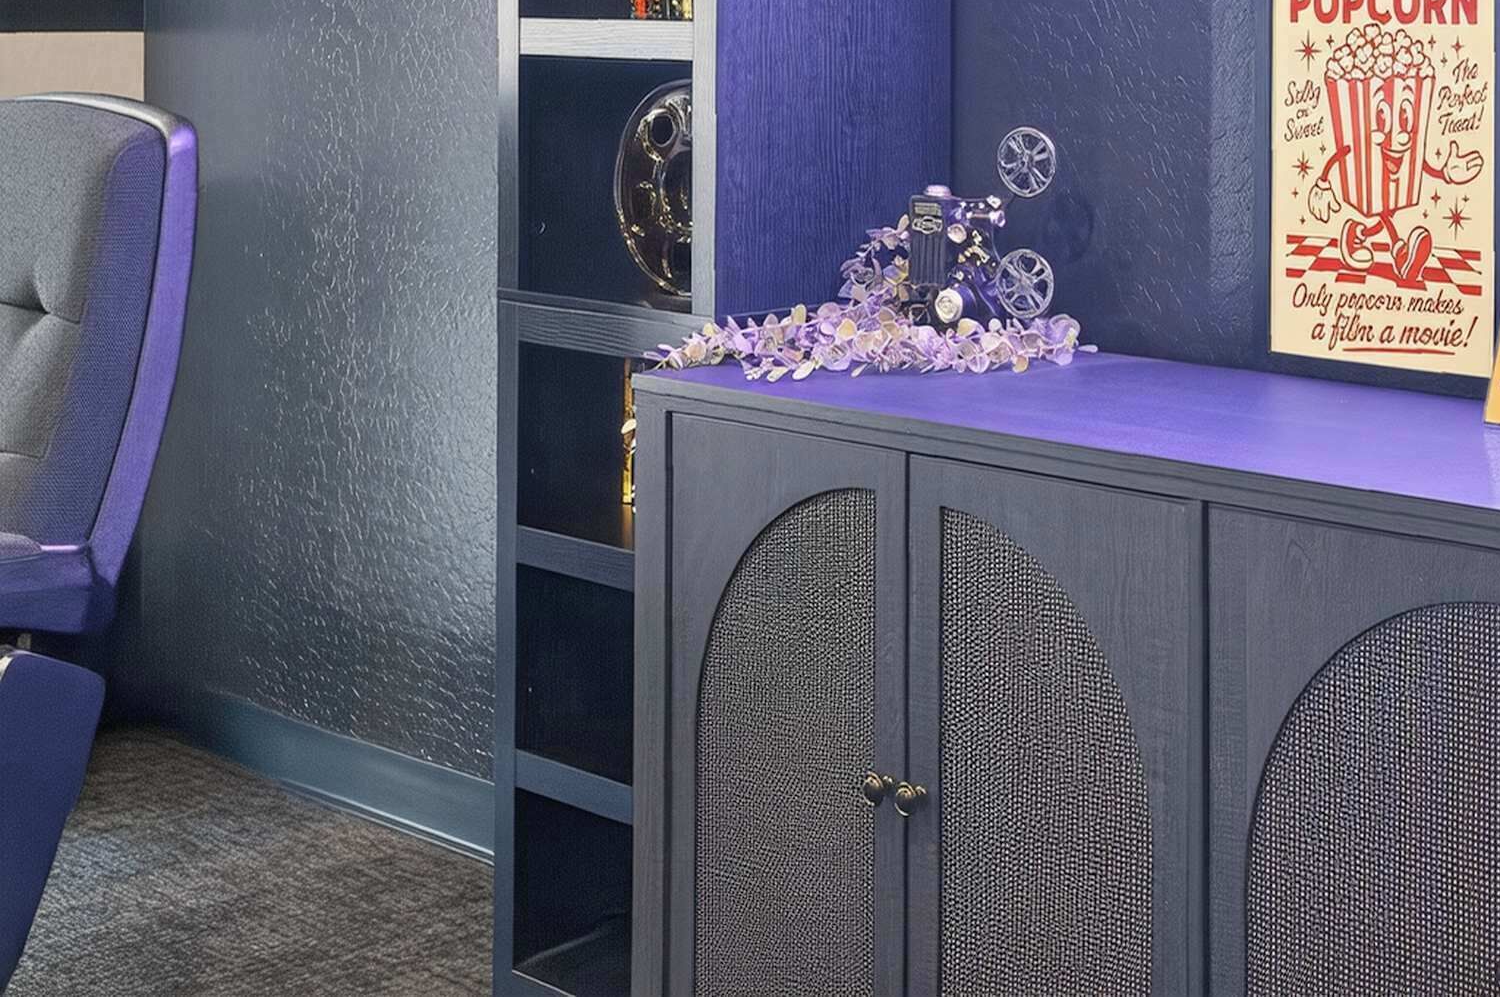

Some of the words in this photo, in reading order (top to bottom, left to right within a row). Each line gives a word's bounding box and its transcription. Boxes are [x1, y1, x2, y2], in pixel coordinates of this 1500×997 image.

[1452, 57, 1478, 84] The
[1437, 82, 1488, 112] Perfect
[1438, 105, 1485, 135] Treat!
[1292, 283, 1333, 316] Only
[1334, 292, 1402, 316] popcorn
[1407, 289, 1464, 315] makes
[1311, 322, 1325, 340] a
[1328, 313, 1375, 350] film
[1379, 325, 1395, 344] a
[1399, 316, 1479, 347] movie!
